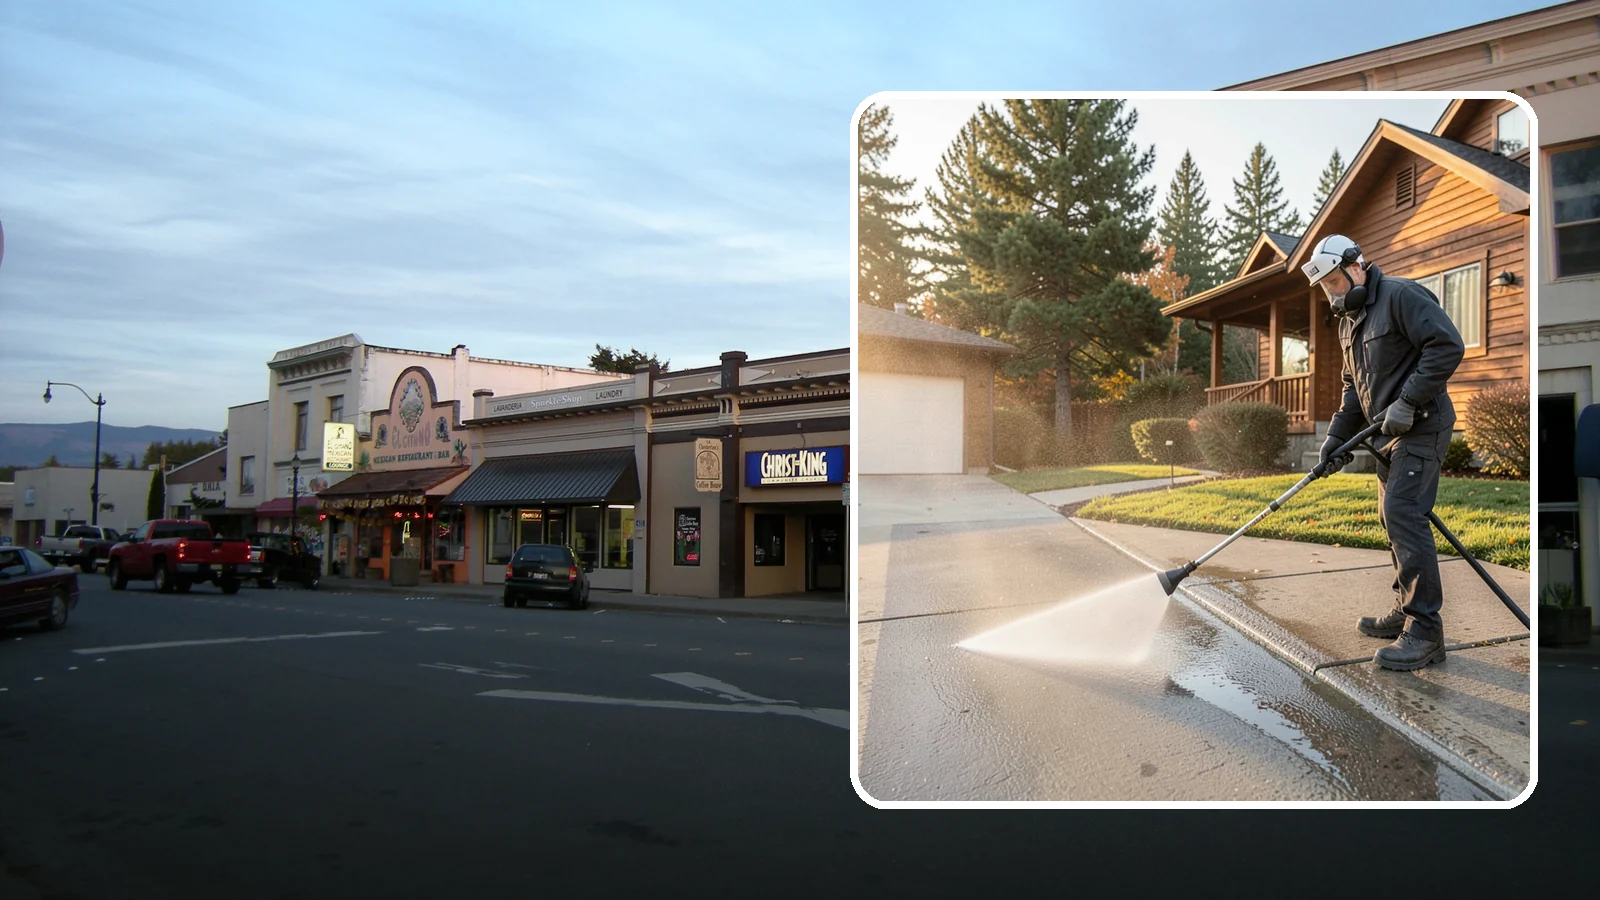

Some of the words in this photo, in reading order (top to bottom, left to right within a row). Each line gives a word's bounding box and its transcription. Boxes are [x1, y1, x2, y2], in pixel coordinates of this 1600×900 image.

[531, 396, 561, 409] Sparkle
[561, 394, 582, 405] Shop
[596, 389, 623, 400] LAUNDRY
[493, 402, 522, 413] LAVANDERIA
[373, 455, 396, 464] MEXICAN
[398, 451, 434, 462] RESTAURANT
[438, 450, 450, 460] BAR
[760, 452, 797, 478] CHRIST
[799, 450, 828, 476] KING
